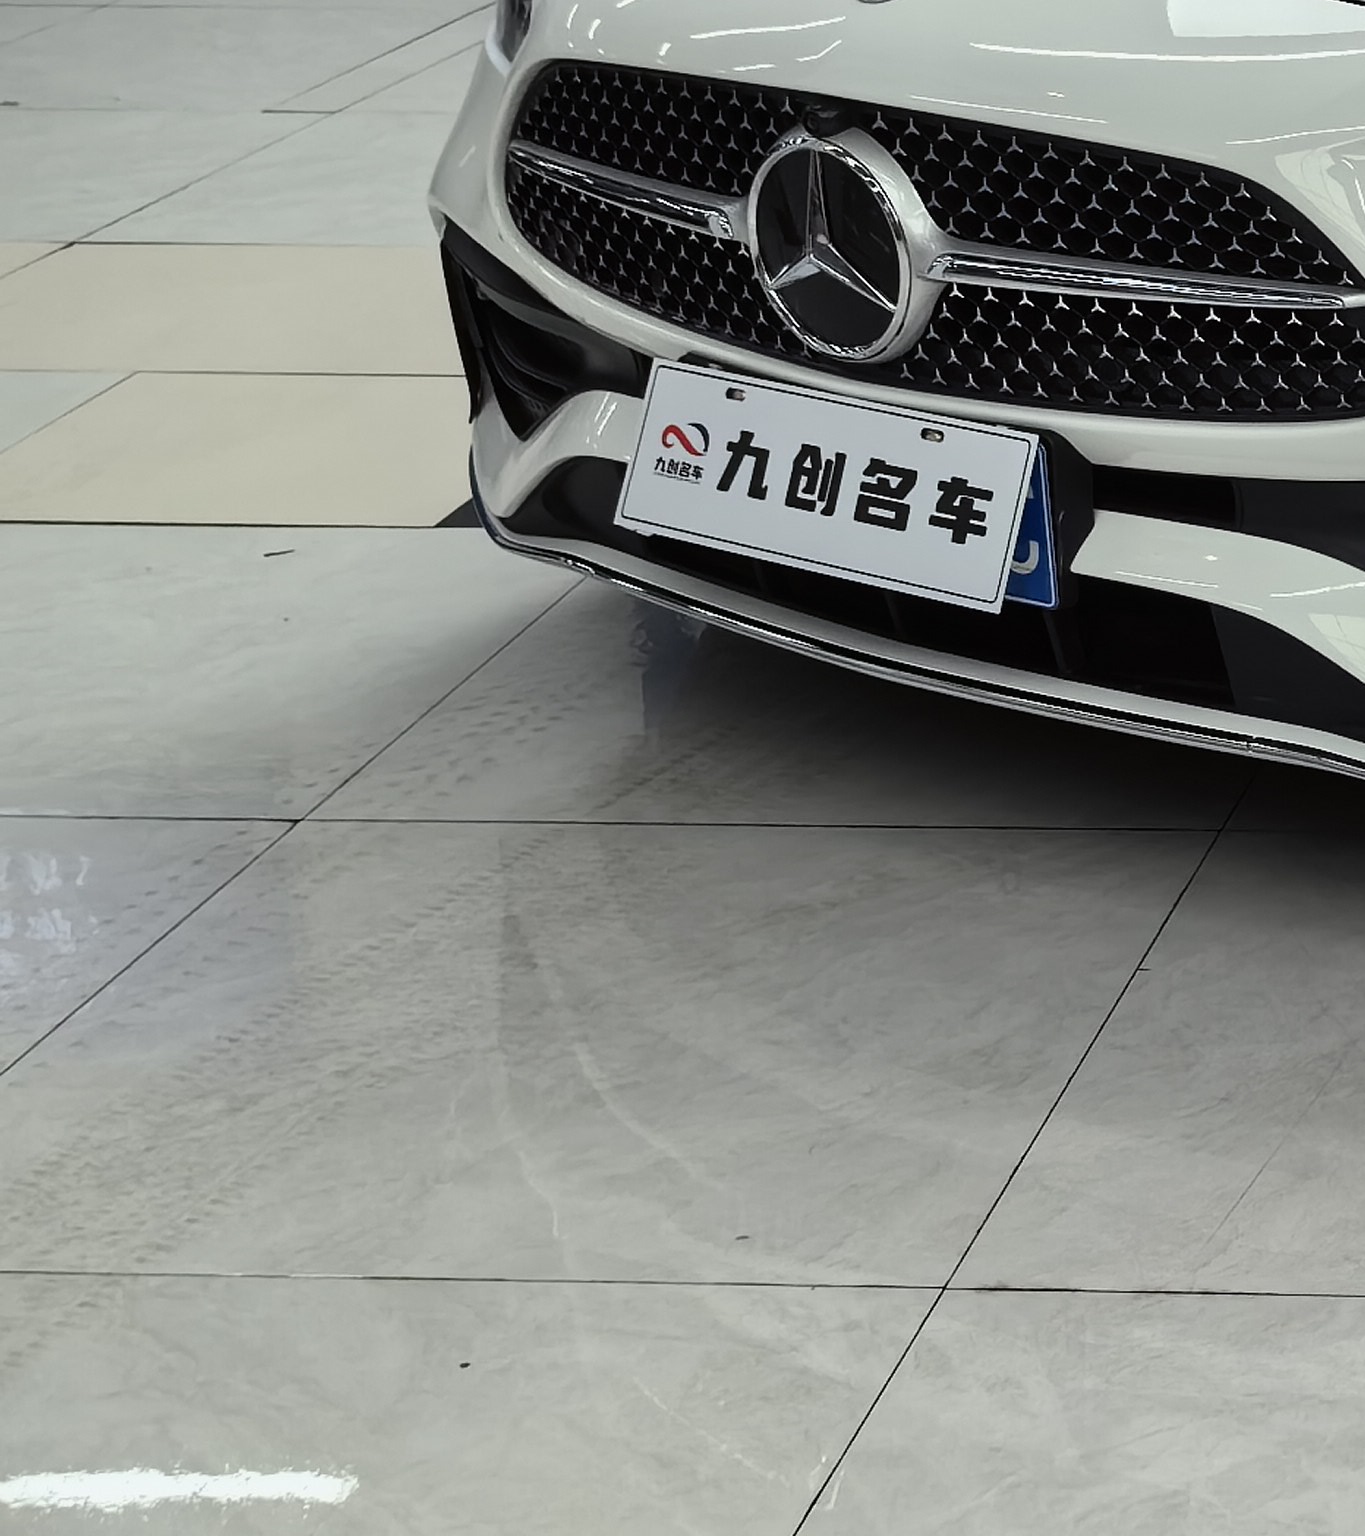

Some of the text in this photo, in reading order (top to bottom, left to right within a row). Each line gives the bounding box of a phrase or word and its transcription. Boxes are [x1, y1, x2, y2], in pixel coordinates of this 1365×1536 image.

[654, 456, 704, 480] 九创名车
[717, 430, 994, 545] 九创名车
